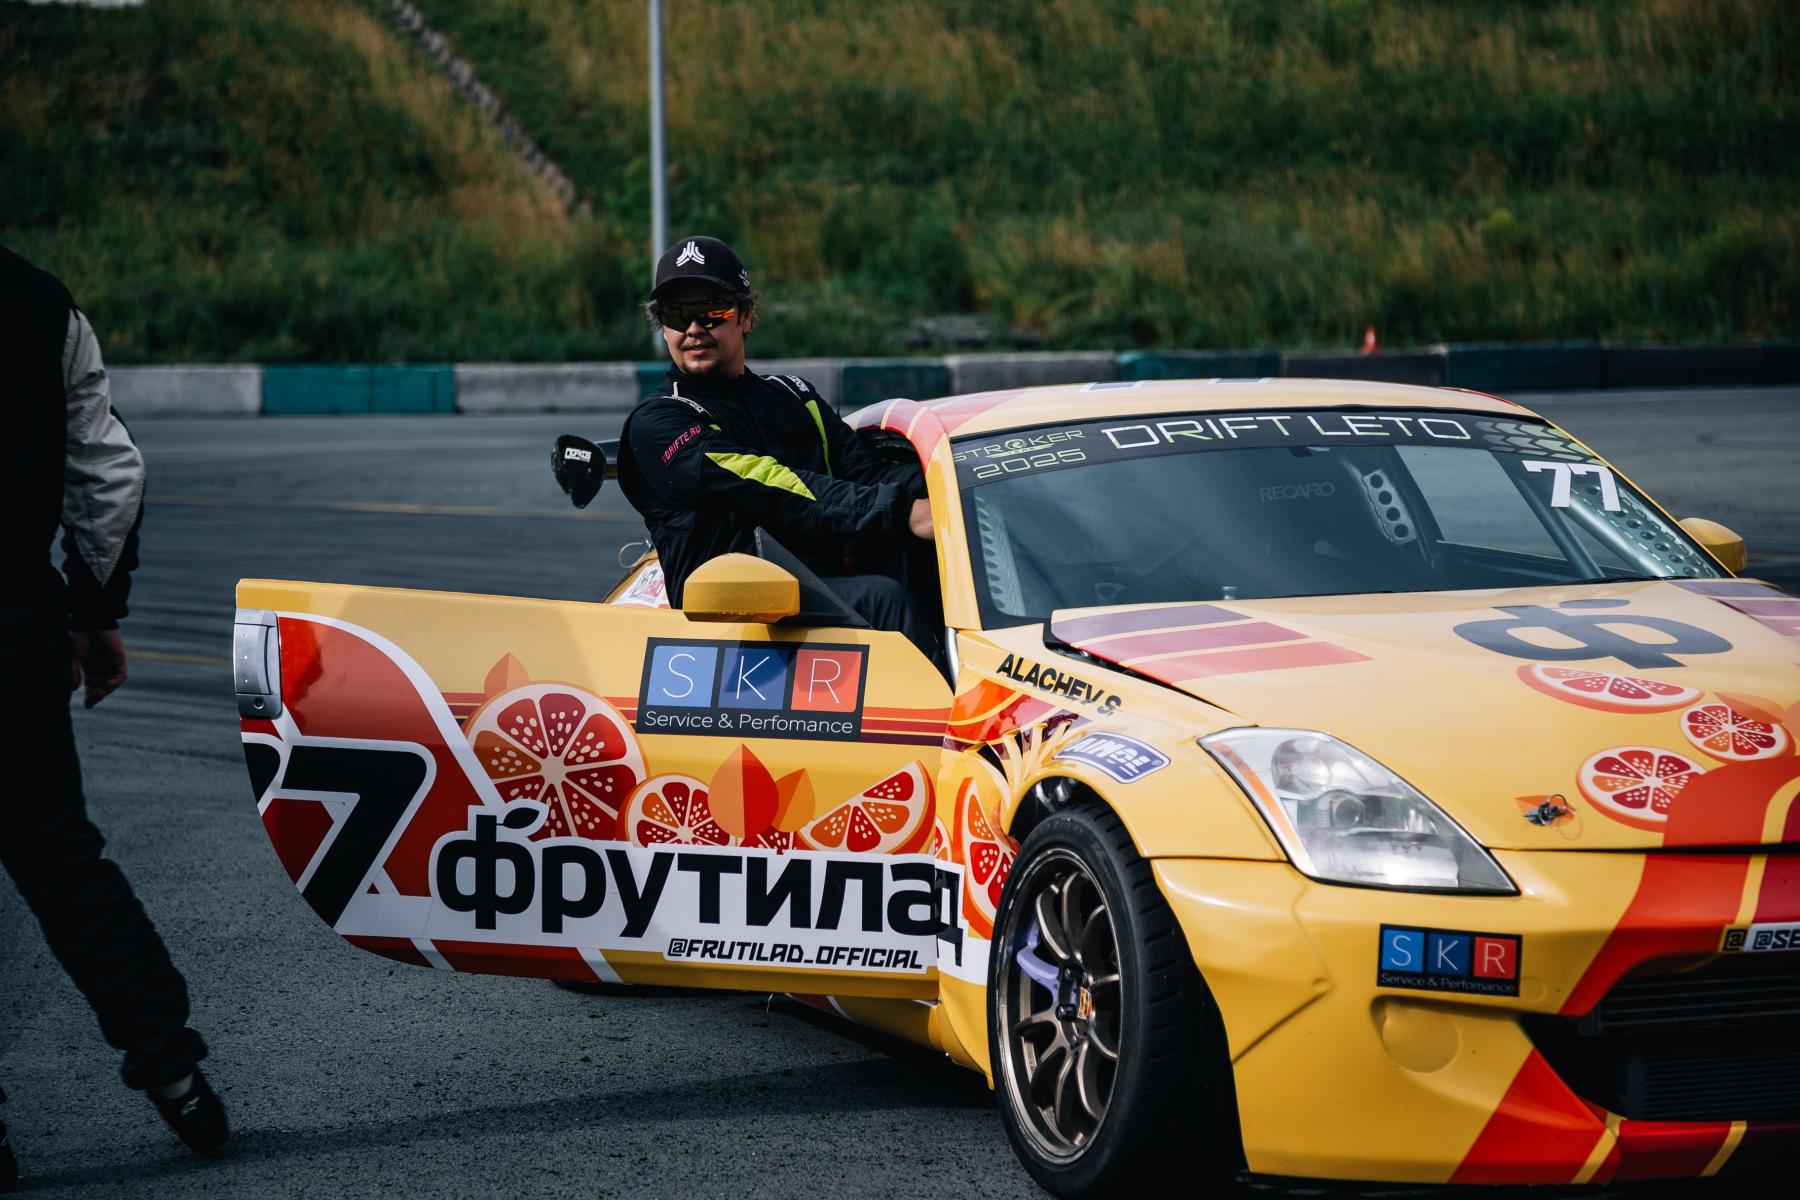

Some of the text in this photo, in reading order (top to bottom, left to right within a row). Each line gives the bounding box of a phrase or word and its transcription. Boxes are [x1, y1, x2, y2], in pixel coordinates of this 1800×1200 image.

[1101, 415, 1472, 449] DRIFT LETO
[973, 448, 1087, 479] 2025
[1259, 481, 1336, 502] RECARO
[1522, 460, 1621, 512] 77
[662, 652, 844, 704] SKR
[995, 653, 1105, 705] ALACHEV
[644, 710, 854, 734] Service & Perfomance
[667, 938, 924, 970] @FRUTILAD_OFFICIAL
[1391, 934, 1507, 975] SKR
[1381, 972, 1516, 993] Service & Perfomance
